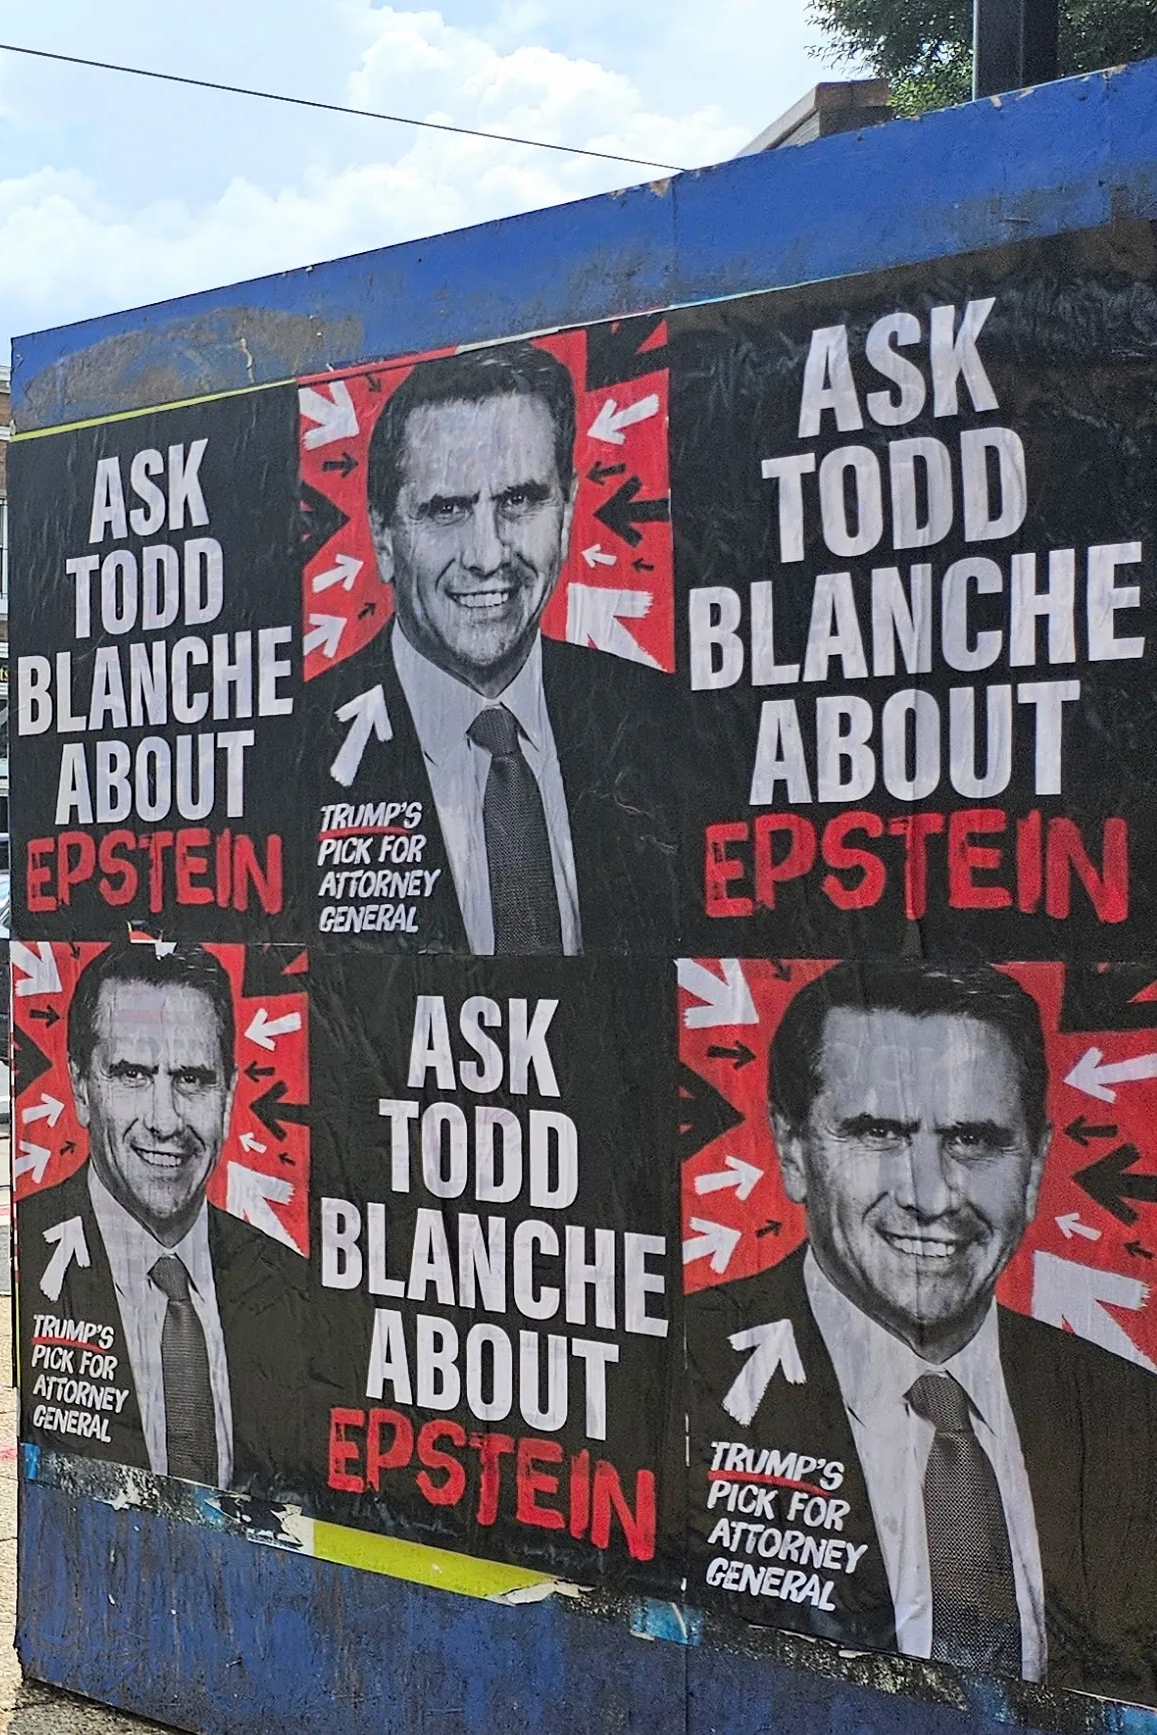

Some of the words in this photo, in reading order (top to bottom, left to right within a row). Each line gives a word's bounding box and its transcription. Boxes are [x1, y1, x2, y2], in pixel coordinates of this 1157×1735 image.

[798, 297, 1000, 438] ASK
[89, 438, 209, 543] ASK
[761, 427, 1028, 563] TODD
[66, 537, 223, 639] TODD
[689, 542, 1145, 691] BLANCHE
[18, 626, 293, 736] BLANCHE
[55, 729, 254, 825] ABOUT
[749, 680, 1081, 805] ABOUT
[317, 836, 373, 866] PICK
[378, 834, 427, 863] FOR
[319, 801, 423, 832] TRUMP'S
[27, 827, 283, 914] EPSTEIN
[318, 869, 441, 899] ATTORNEY
[704, 808, 1130, 923] EPSTEIN
[319, 903, 419, 933] GENERAL
[407, 995, 561, 1098] ASK
[379, 1098, 579, 1209] TODD
[321, 1197, 669, 1338] BLANCHE
[31, 1344, 74, 1374] PICK
[79, 1351, 119, 1381] FOR
[33, 1314, 115, 1349] TRUMP'S
[366, 1308, 619, 1441] ABOUT
[32, 1374, 130, 1414] ATTORNEY
[33, 1404, 112, 1443] GENERAL
[327, 1407, 657, 1562] EPSTEIN
[707, 1480, 779, 1520] PICK
[787, 1491, 851, 1531] FOR
[710, 1441, 845, 1491] TRUMP'S
[706, 1557, 836, 1612] GENERAL
[707, 1518, 869, 1574] ATTORNEY
